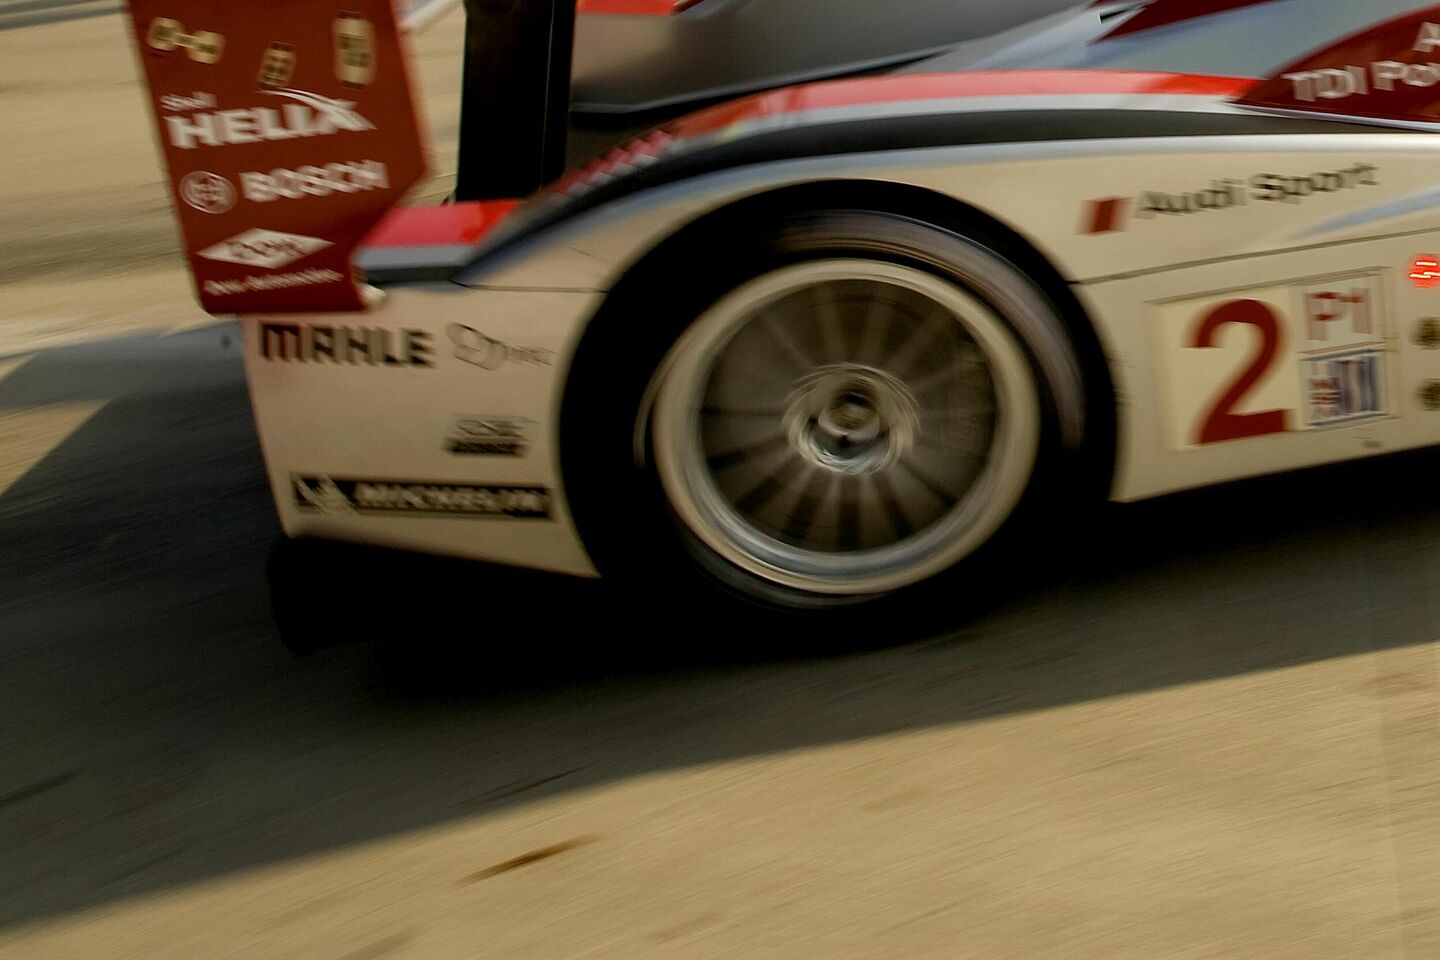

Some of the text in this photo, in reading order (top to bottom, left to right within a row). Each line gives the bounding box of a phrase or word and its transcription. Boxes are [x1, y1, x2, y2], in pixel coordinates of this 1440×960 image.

[1282, 66, 1369, 102] TDI
[162, 93, 378, 149] HELIX
[239, 159, 391, 202] BOSCH
[1134, 163, 1382, 220] Audi Sport
[1304, 287, 1374, 341] P1
[258, 321, 436, 369] MAHLE
[1184, 299, 1294, 445] 2
